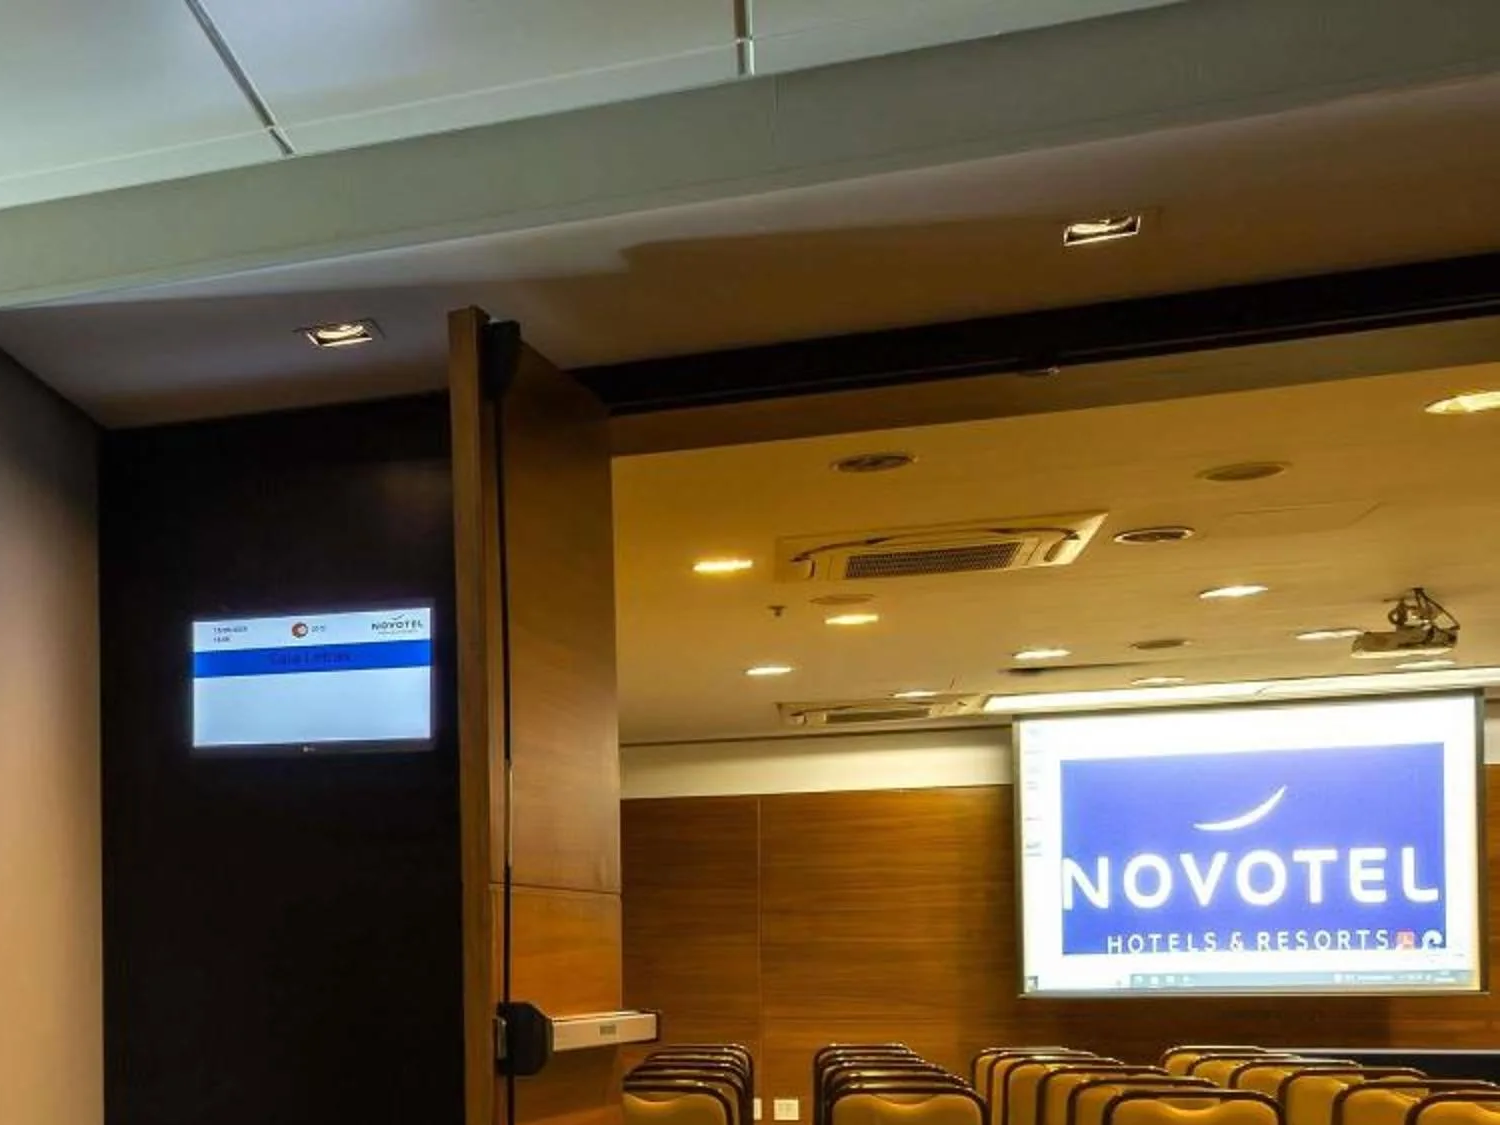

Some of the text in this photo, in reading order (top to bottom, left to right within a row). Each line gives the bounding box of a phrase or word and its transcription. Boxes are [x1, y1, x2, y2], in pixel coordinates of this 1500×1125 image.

[371, 619, 423, 632] NOVOTEL
[1062, 847, 1439, 911] NOVOTEL
[1106, 929, 1388, 954] HOTELS & RESORTS
